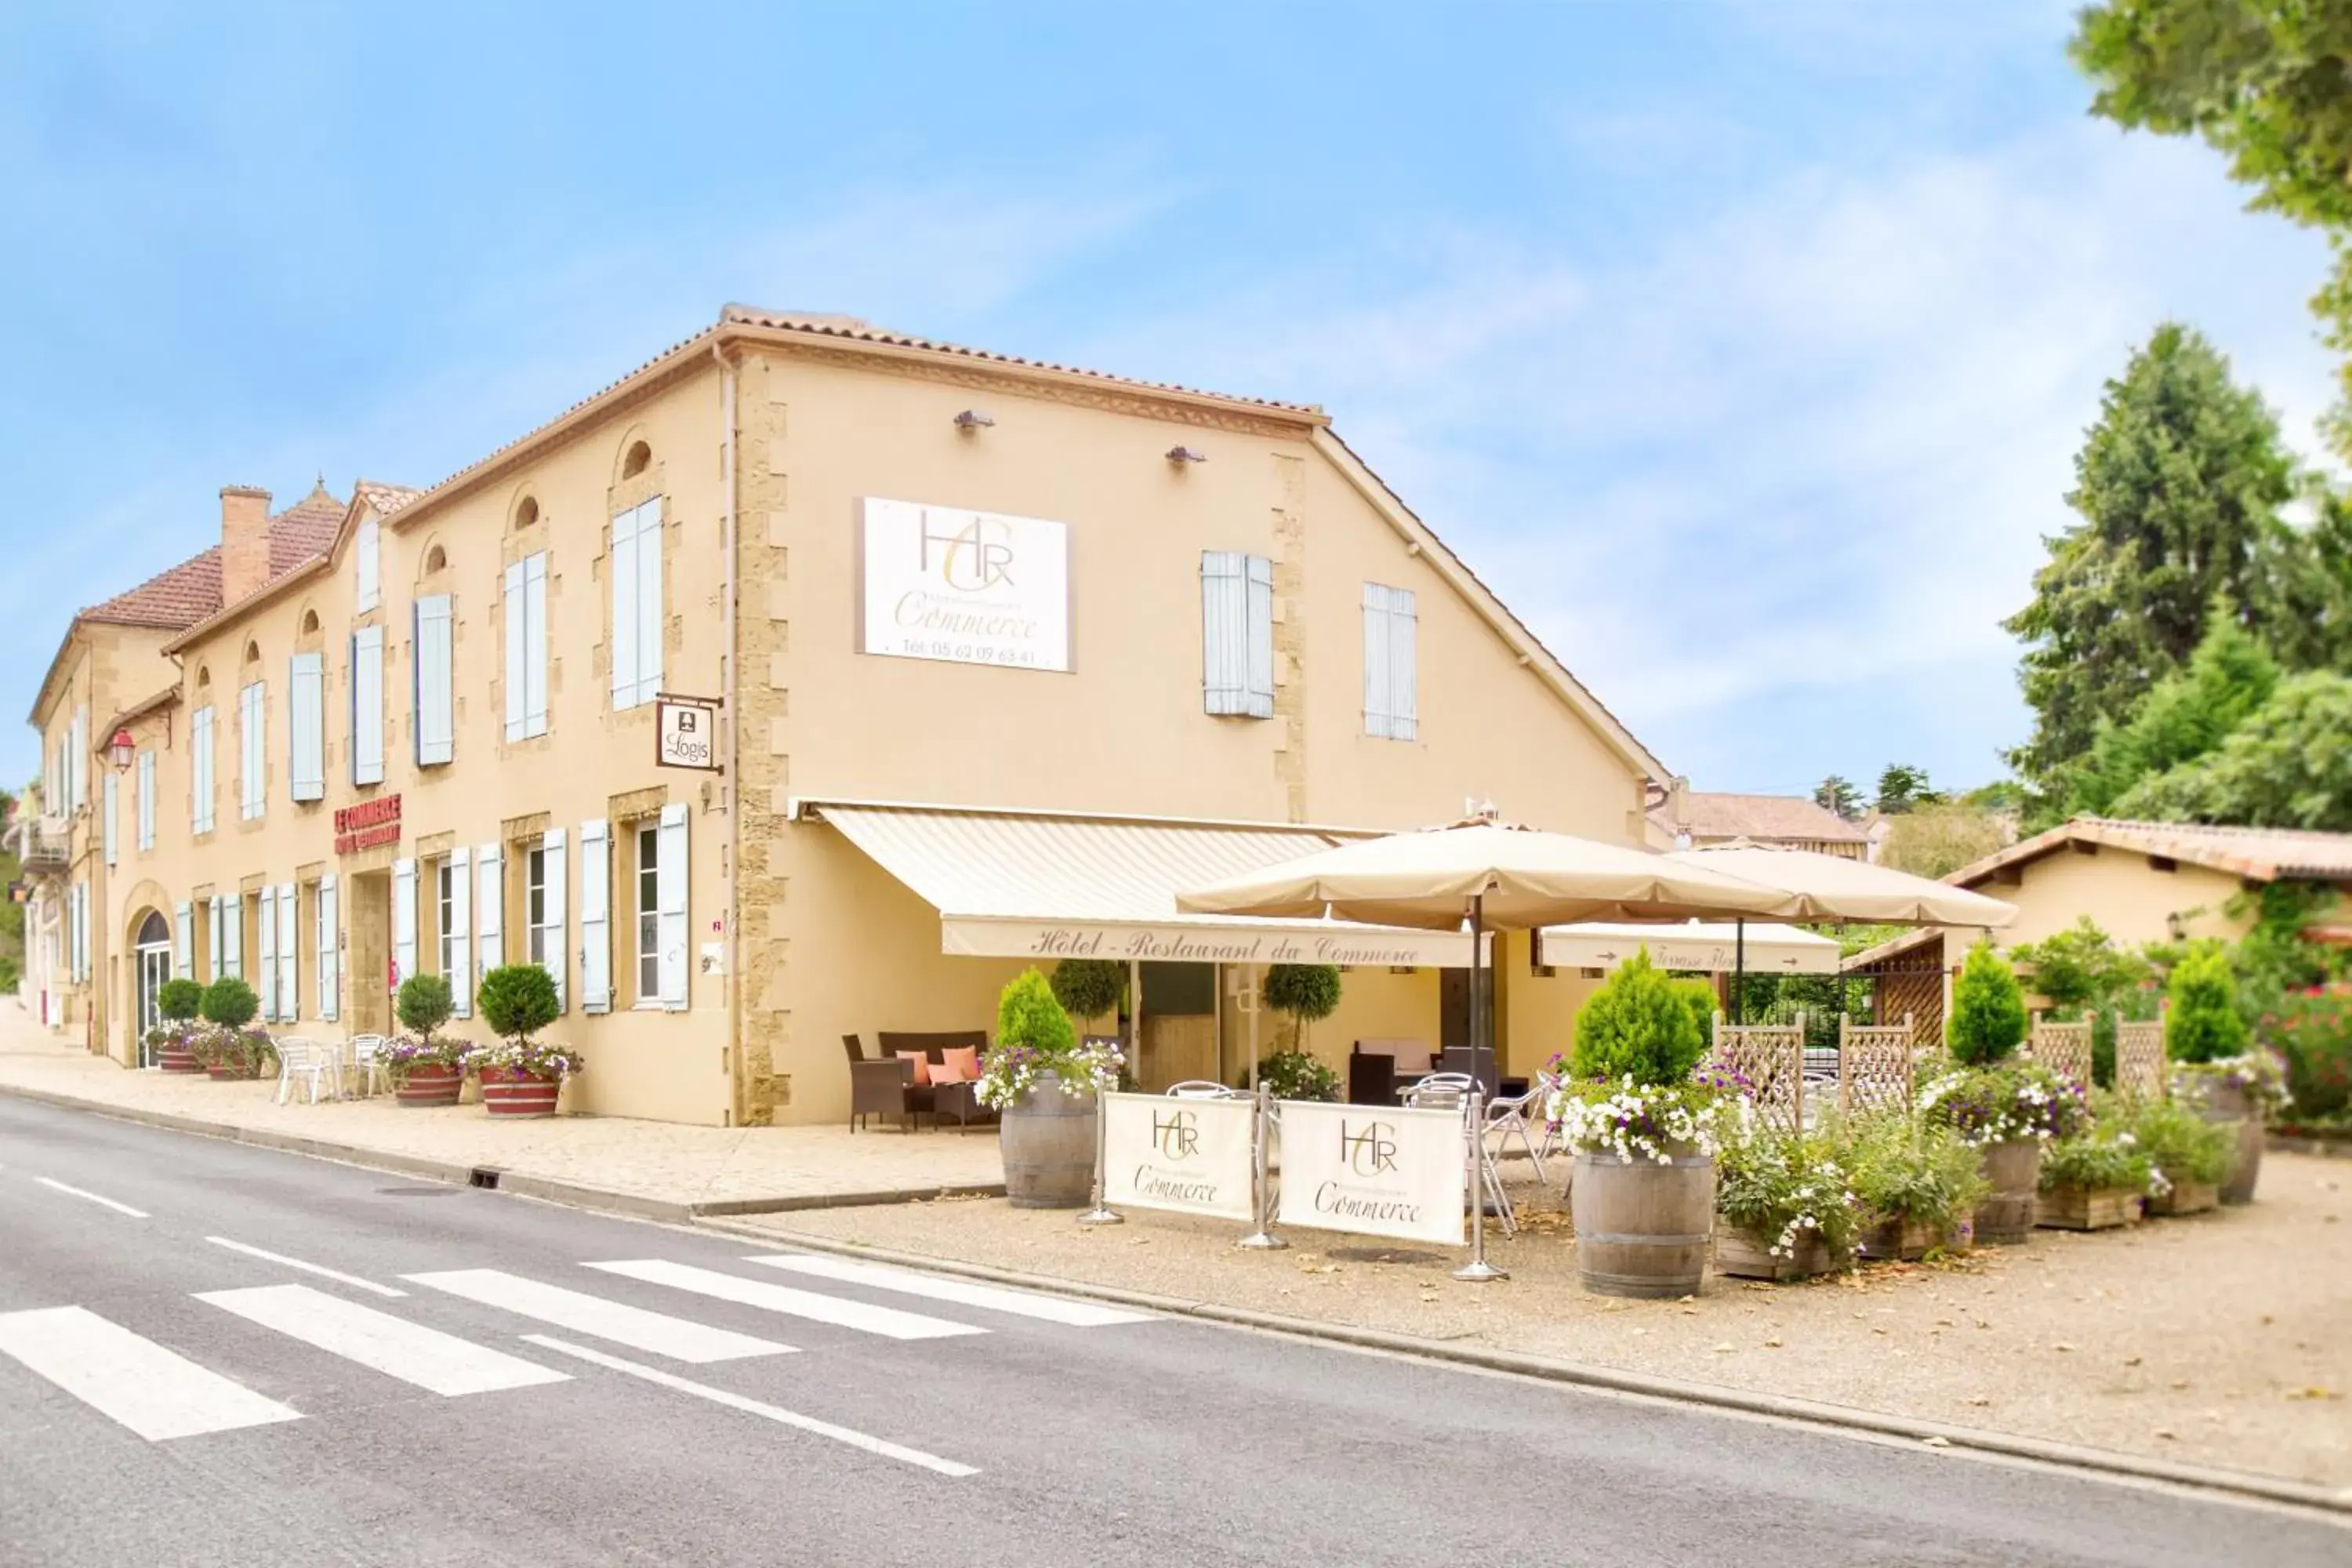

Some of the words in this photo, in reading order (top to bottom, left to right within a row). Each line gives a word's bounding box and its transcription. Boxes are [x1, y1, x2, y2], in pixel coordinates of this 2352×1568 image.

[895, 590, 1038, 639] Commerce
[932, 642, 950, 657] 05
[955, 644, 972, 659] 62
[976, 646, 994, 661] 09
[998, 648, 1017, 663] 63
[1020, 651, 1035, 665] 41
[665, 731, 709, 763] Logis
[347, 793, 401, 831] COMMERCE
[1031, 929, 1103, 954] Hôtel
[1125, 931, 1262, 958] Restaurant
[1271, 937, 1302, 961] du
[1314, 935, 1419, 964] Commerce
[1134, 1163, 1218, 1202] Commerce
[1314, 1180, 1424, 1223] Commerce
